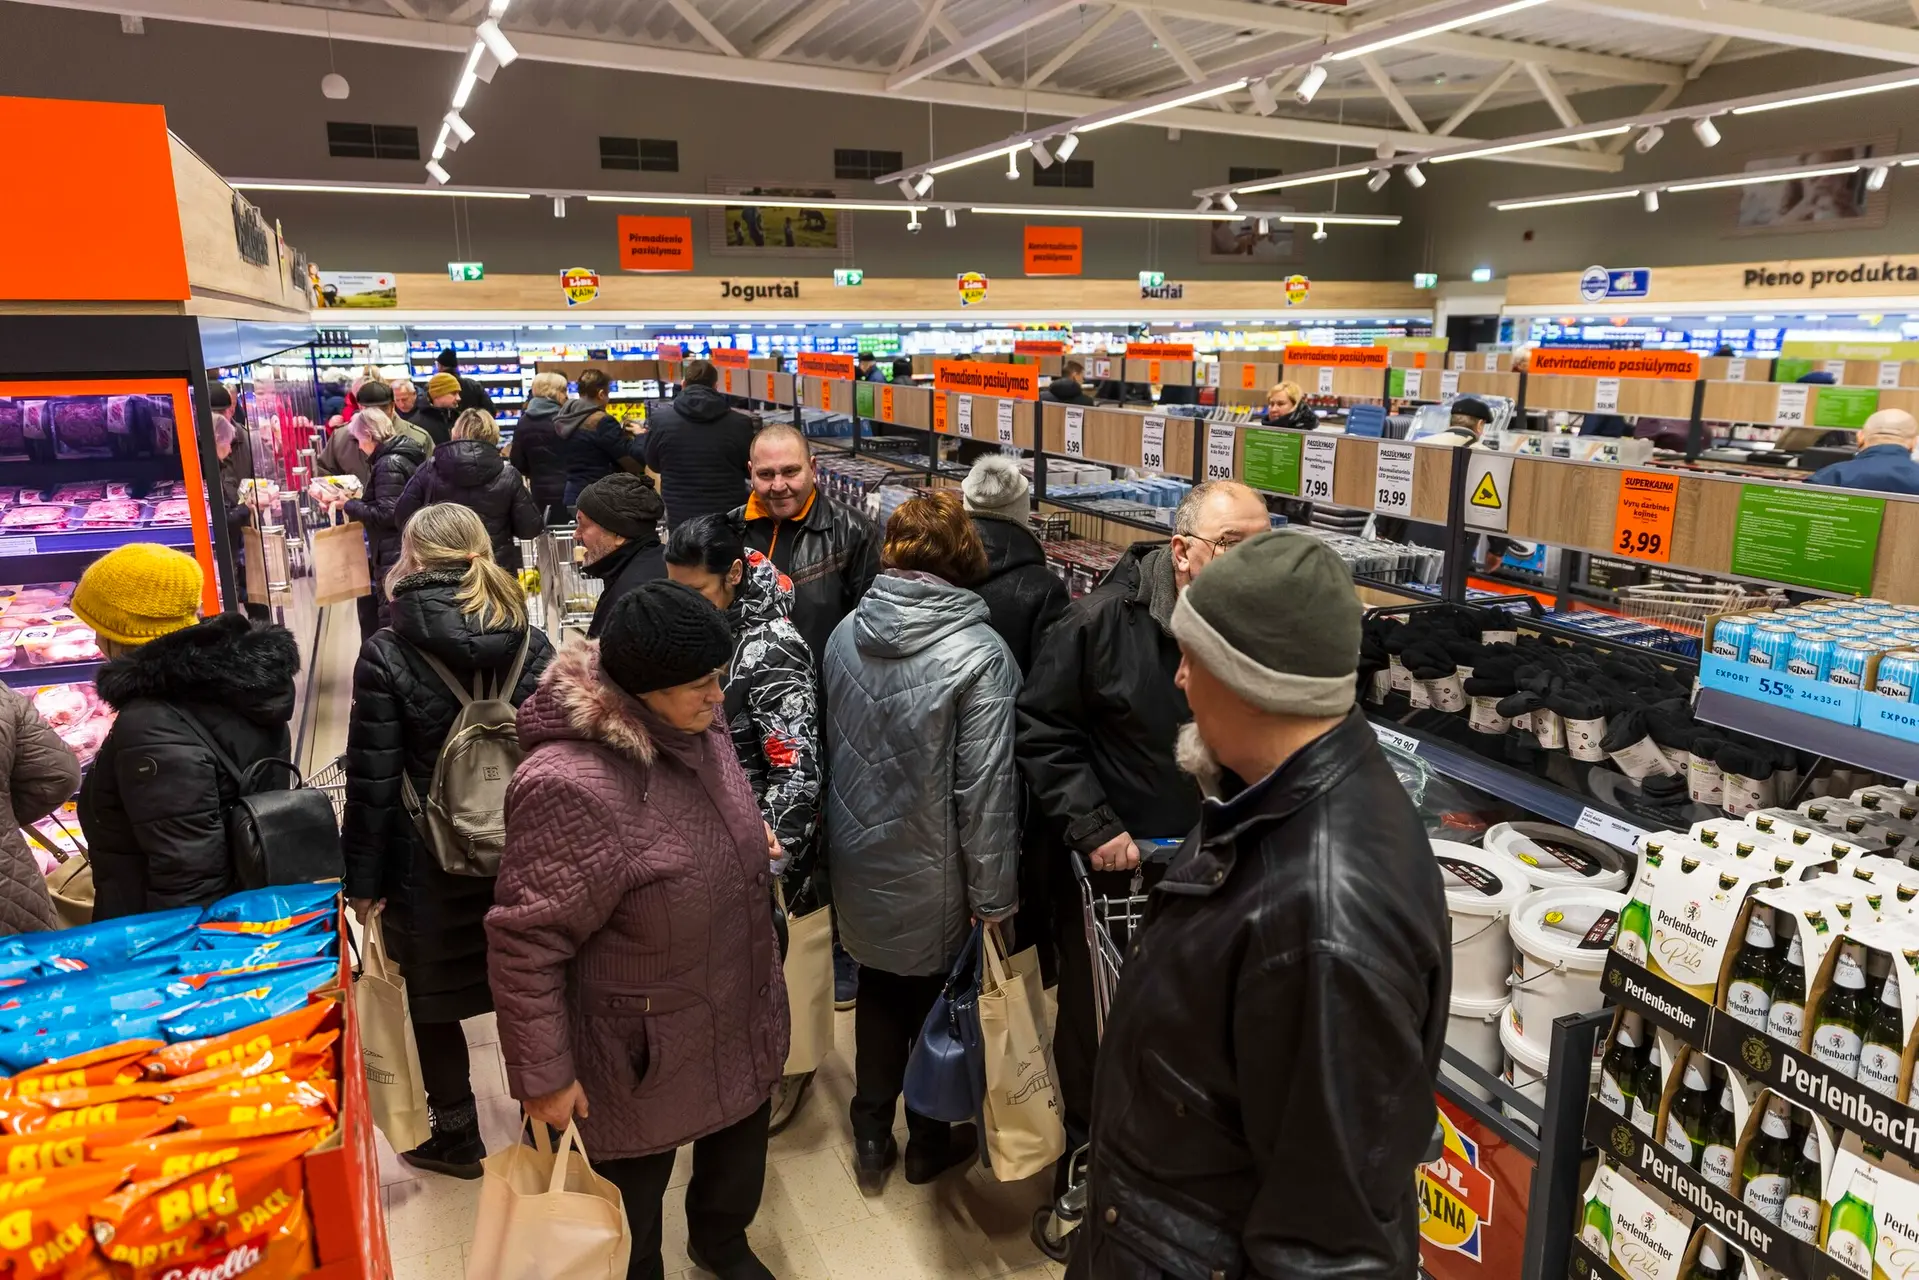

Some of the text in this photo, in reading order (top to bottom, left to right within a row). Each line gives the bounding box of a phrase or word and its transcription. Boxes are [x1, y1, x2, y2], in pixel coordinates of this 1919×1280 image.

[629, 233, 683, 245] Pirmadienio
[1744, 262, 1919, 289] Pieno produkta
[721, 281, 800, 301] Jogurtai
[1288, 350, 1384, 365] Ketvirtadienio pasiūlymas
[1535, 354, 1693, 376] Ketvirtadienio pasiūlymas
[940, 367, 1030, 392] Pirmadienio pasiūlymas
[1066, 441, 1080, 453] 5,99
[1144, 452, 1161, 468] 9,99
[1209, 464, 1231, 479] 29,90
[1305, 478, 1328, 497] 7,99
[1625, 477, 1674, 491] SUPERKAINA
[1378, 488, 1406, 506] 13,99
[1641, 501, 1670, 512] darbinės
[1633, 509, 1658, 519] kojinės
[1619, 529, 1662, 554] 3,99
[1715, 669, 1750, 683] EXPORT
[1759, 677, 1794, 696] 5,5%
[1801, 690, 1812, 699] 24
[1820, 696, 1832, 704] 33
[1833, 699, 1841, 707] cl
[1880, 710, 1919, 727] EXPOR
[1392, 736, 1415, 752] 7990
[1657, 909, 1718, 948] Perlenbacher
[1660, 937, 1702, 969] Pils
[1624, 976, 1696, 1029] Perlenbacher
[1728, 997, 1768, 1017] Perlenbache
[1769, 1017, 1802, 1038] Perlenbac
[1813, 1039, 1860, 1062] Perlenbache
[1860, 1062, 1899, 1085] Perlenbach
[1780, 1053, 1919, 1154] Perlenbach
[1428, 1157, 1469, 1198] DL
[1703, 1157, 1733, 1178] Perlenba
[158, 1173, 239, 1233] BIG
[1419, 1179, 1467, 1234] AINA
[1641, 1143, 1773, 1254] Perlenbacher
[1749, 1189, 1783, 1205] Perlenba
[237, 1187, 293, 1233] PACK
[1783, 1207, 1818, 1232] Perlenbac
[29, 1222, 88, 1272] PACK
[1617, 1213, 1674, 1261] Perlenbacher
[110, 1236, 188, 1268] PARTY
[1621, 1242, 1660, 1276] Pils
